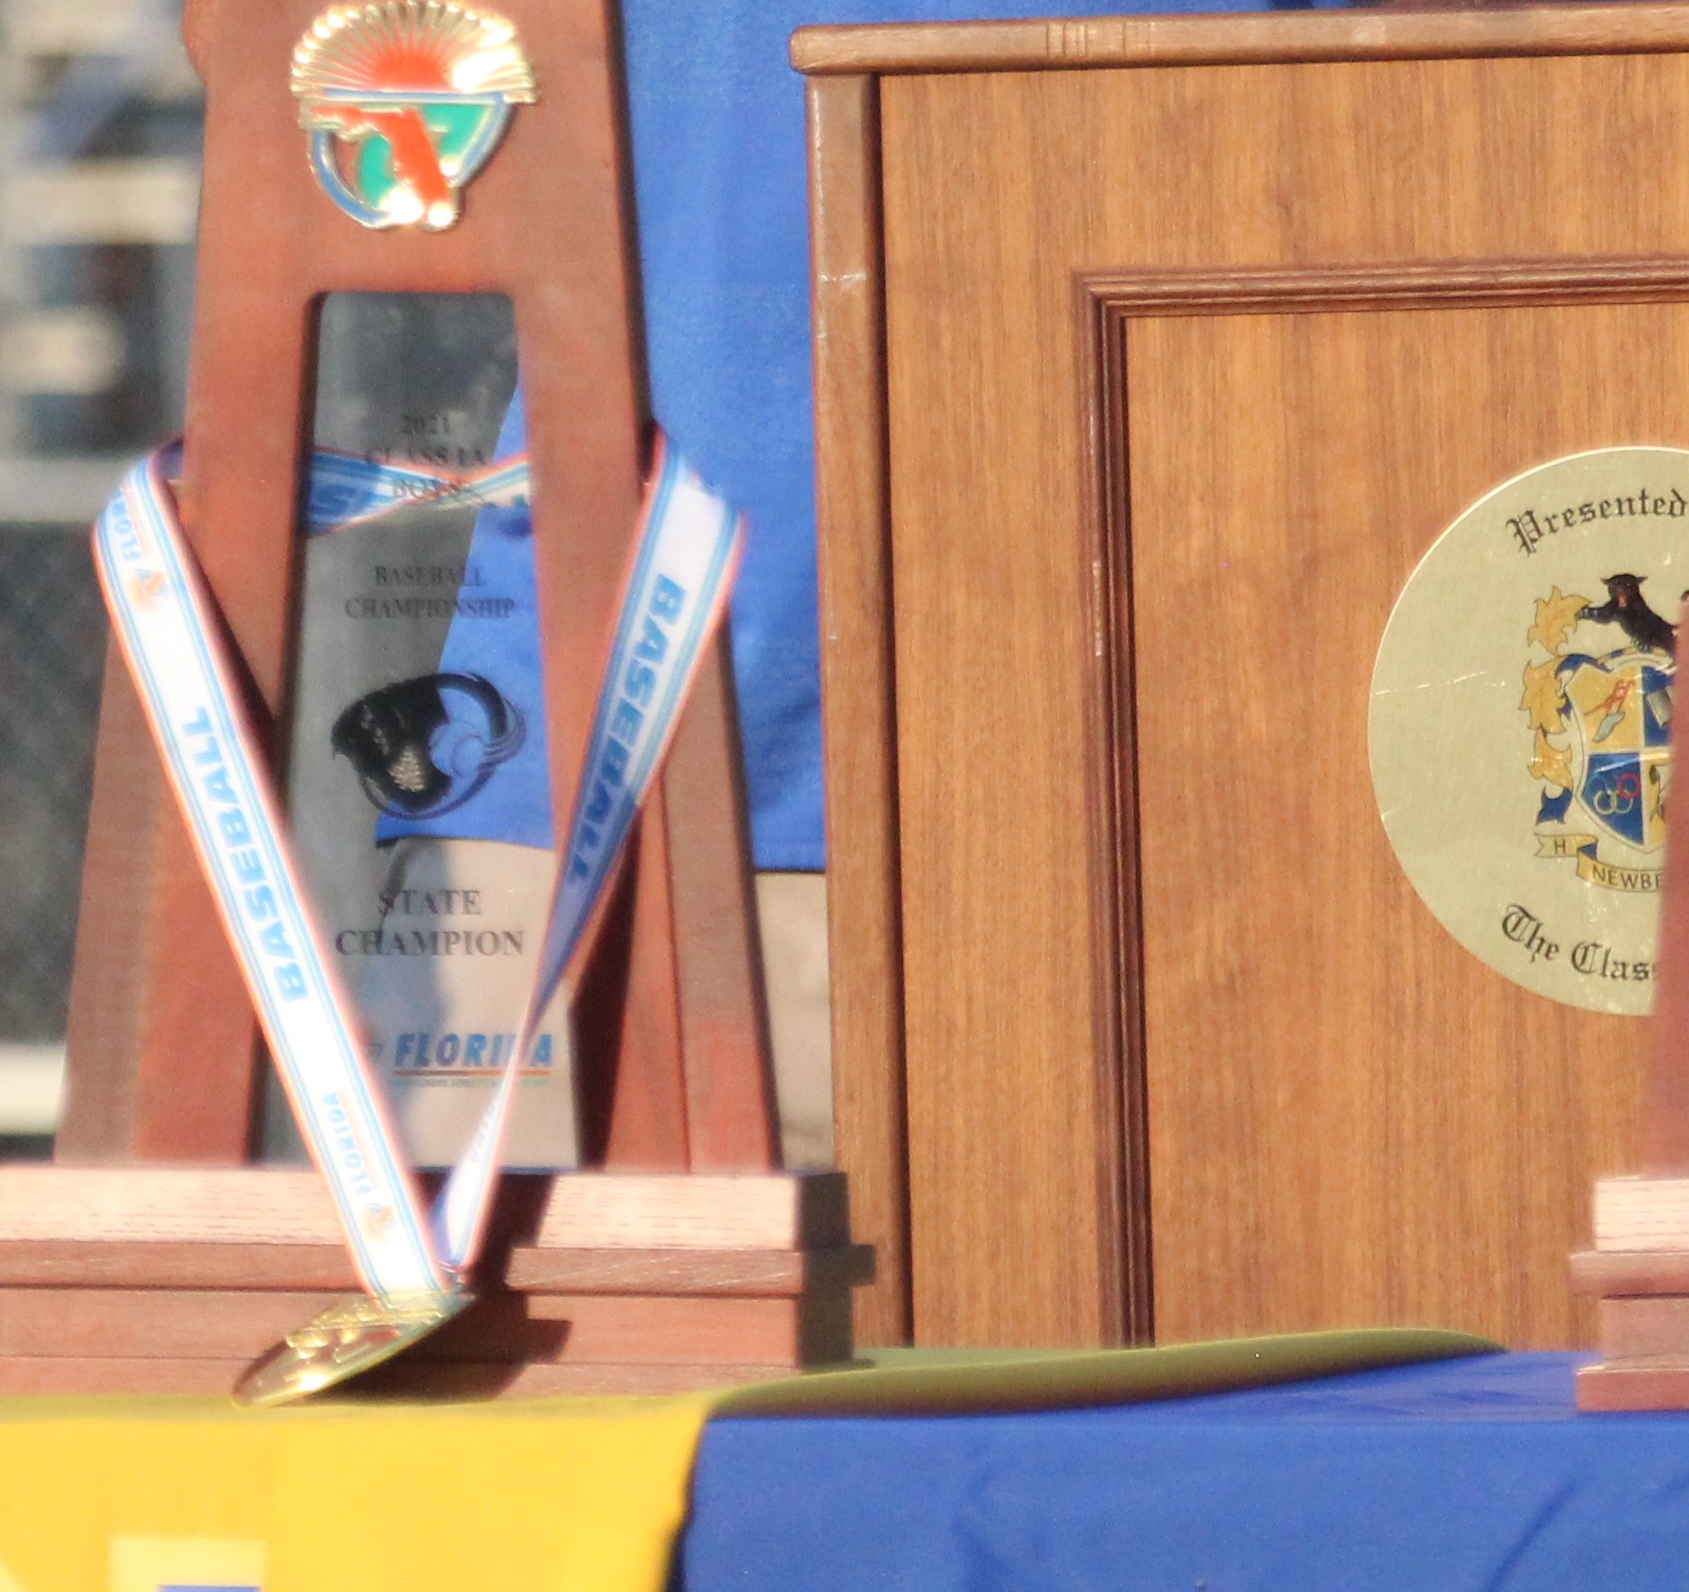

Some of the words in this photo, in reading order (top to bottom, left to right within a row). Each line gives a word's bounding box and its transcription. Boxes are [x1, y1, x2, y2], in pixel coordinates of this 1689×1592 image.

[365, 446, 449, 466] CLASS
[111, 489, 142, 560] FLOR
[1505, 488, 1689, 557] Presented
[375, 565, 487, 587] BASEBALL
[345, 597, 516, 619] CHAMPIONSHIP
[570, 573, 687, 884] BASEBALL
[182, 705, 308, 1002] BASEBALL
[1554, 839, 1566, 854] H
[1591, 864, 1663, 890] NEWBE
[378, 889, 481, 915] STATE
[335, 929, 524, 956] CHAMPION
[1501, 904, 1560, 963] The
[322, 1091, 373, 1195] FLORIDA
